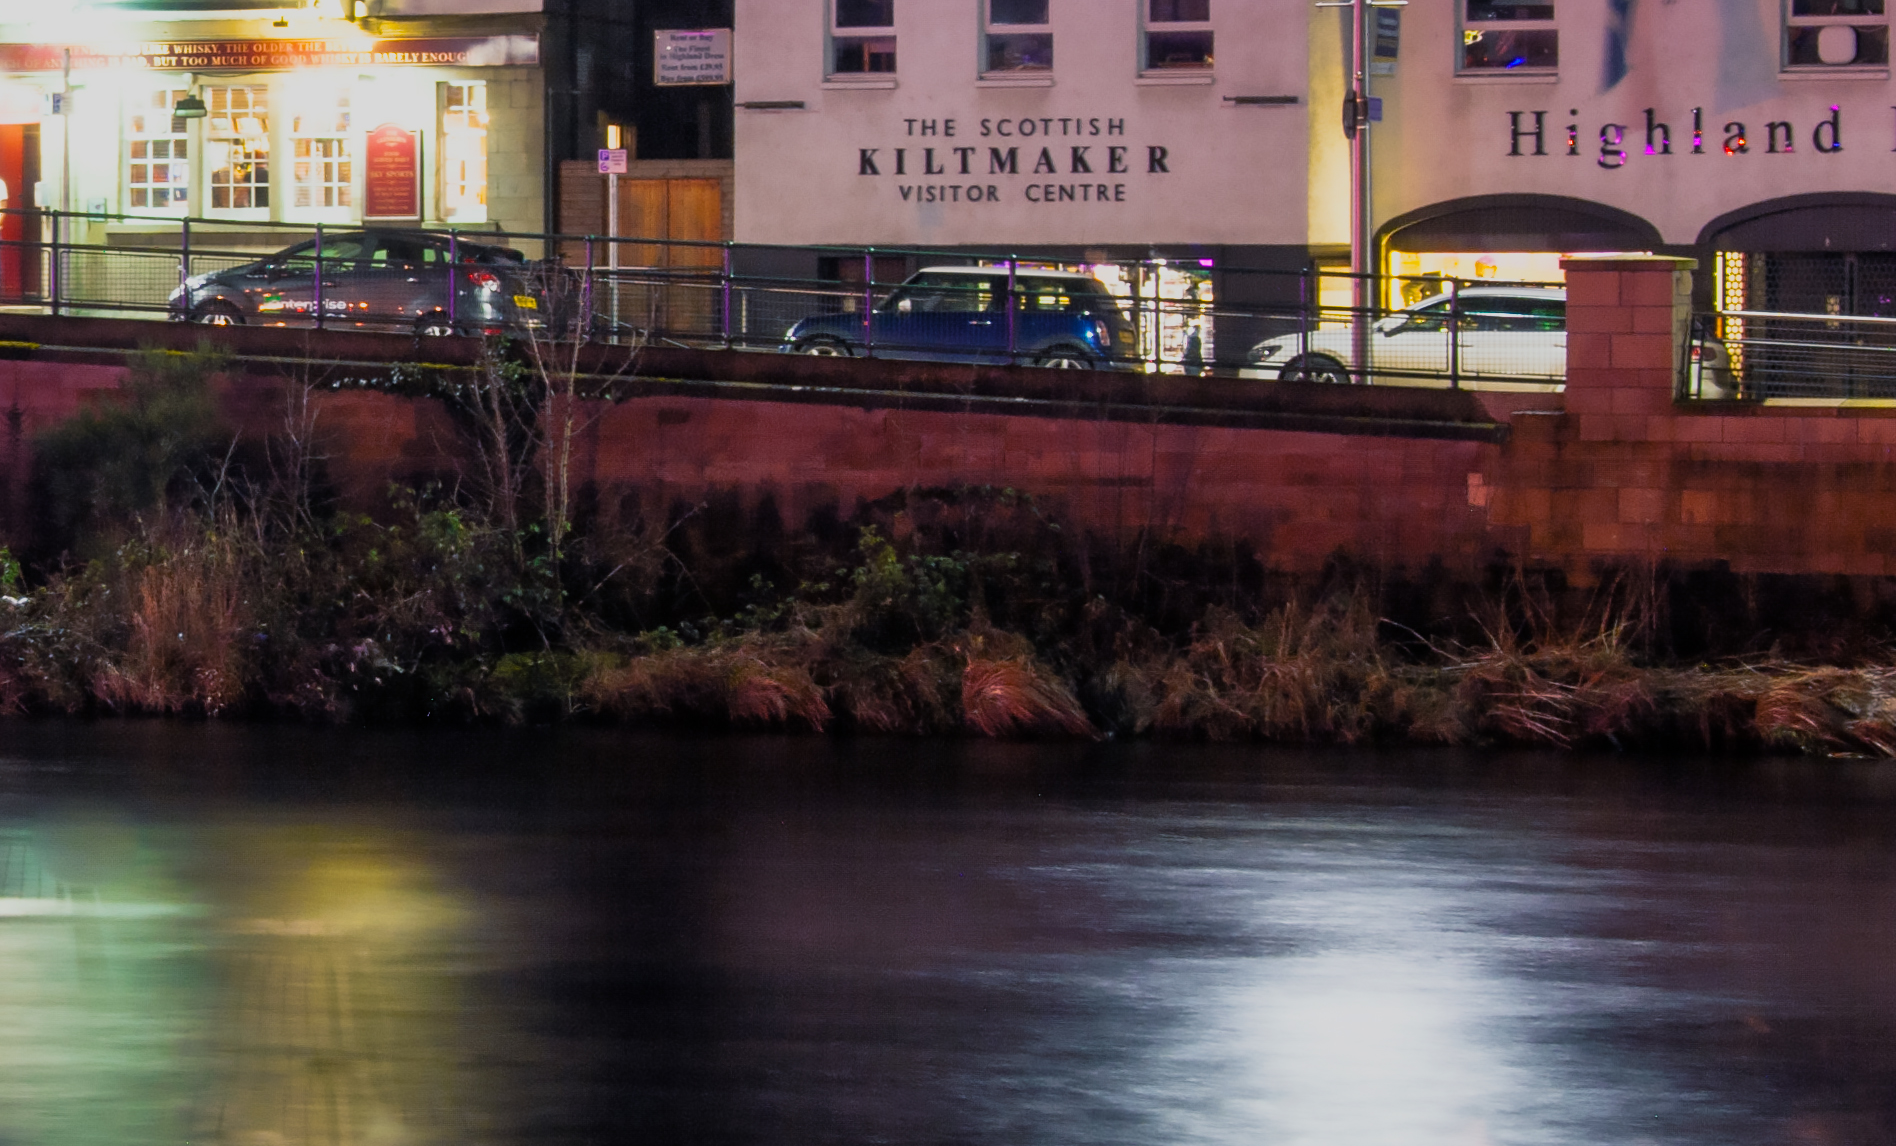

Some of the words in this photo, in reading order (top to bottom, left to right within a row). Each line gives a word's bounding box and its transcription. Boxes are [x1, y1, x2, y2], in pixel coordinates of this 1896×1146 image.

[173, 43, 221, 56] WHISKY,
[226, 43, 249, 53] THE
[253, 42, 293, 53] OLDER
[297, 41, 322, 52] THE
[153, 56, 177, 67] BUT
[181, 56, 208, 66] TOO
[211, 55, 247, 66] MUCH
[250, 55, 267, 65] OF
[271, 54, 306, 65] GOOD
[310, 53, 357, 65] WHISKY
[422, 51, 473, 63] ENOUG
[903, 118, 956, 137] THE
[980, 117, 1125, 137] SCOTTISH
[1505, 104, 1843, 170] Highland
[858, 145, 1170, 176] KILTMAKER
[899, 184, 1001, 203] VISITOR
[1025, 183, 1126, 202] CENTRE
